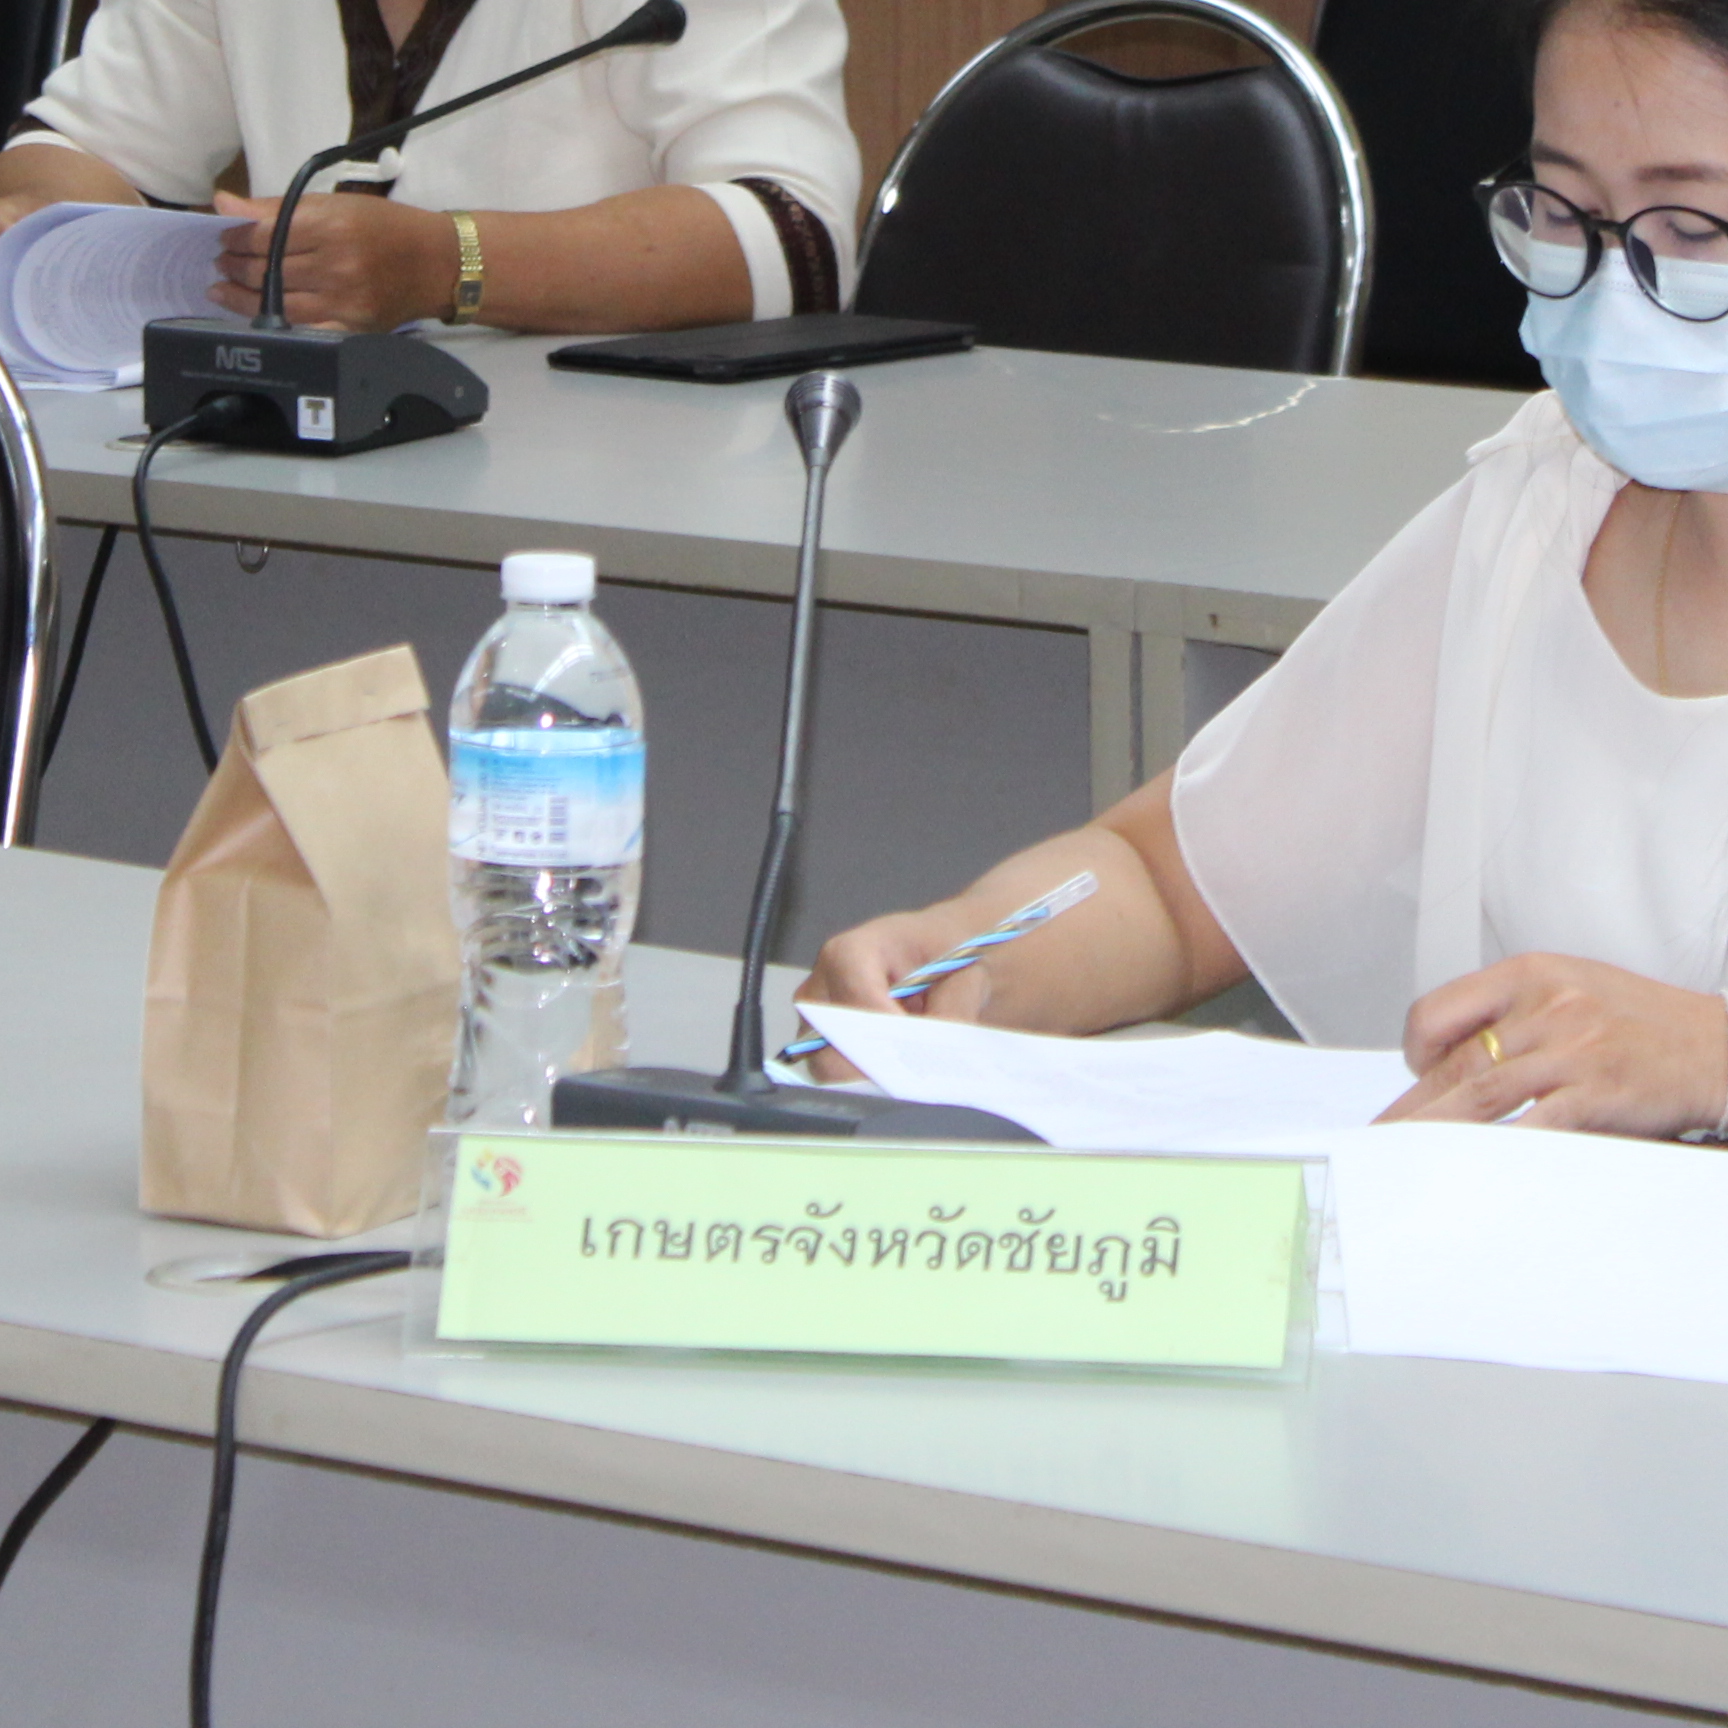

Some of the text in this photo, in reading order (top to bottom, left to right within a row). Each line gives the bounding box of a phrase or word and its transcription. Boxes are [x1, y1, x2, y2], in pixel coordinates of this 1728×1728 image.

[305, 399, 325, 425] T
[578, 1201, 1182, 1303] เกษตรจังหวัดชัยภูมิ
